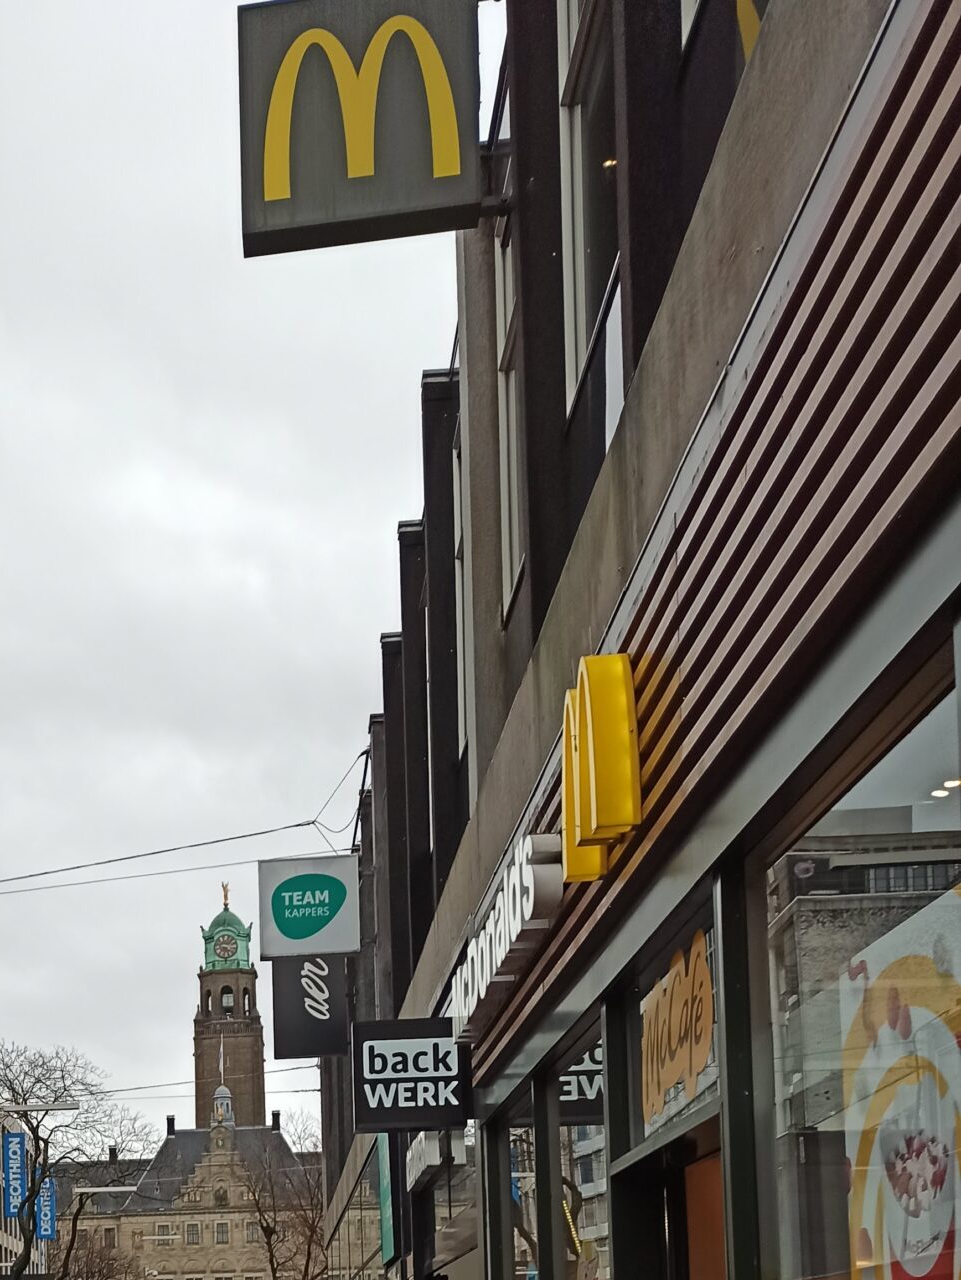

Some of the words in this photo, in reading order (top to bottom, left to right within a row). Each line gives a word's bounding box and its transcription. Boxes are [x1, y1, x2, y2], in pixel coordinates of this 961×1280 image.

[281, 889, 329, 906] TEAM
[285, 906, 330, 918] KAPPERS
[645, 952, 703, 1104] McCafé
[368, 1042, 453, 1075] back
[363, 1080, 459, 1108] WERK
[8, 1137, 22, 1213] DECATHLON
